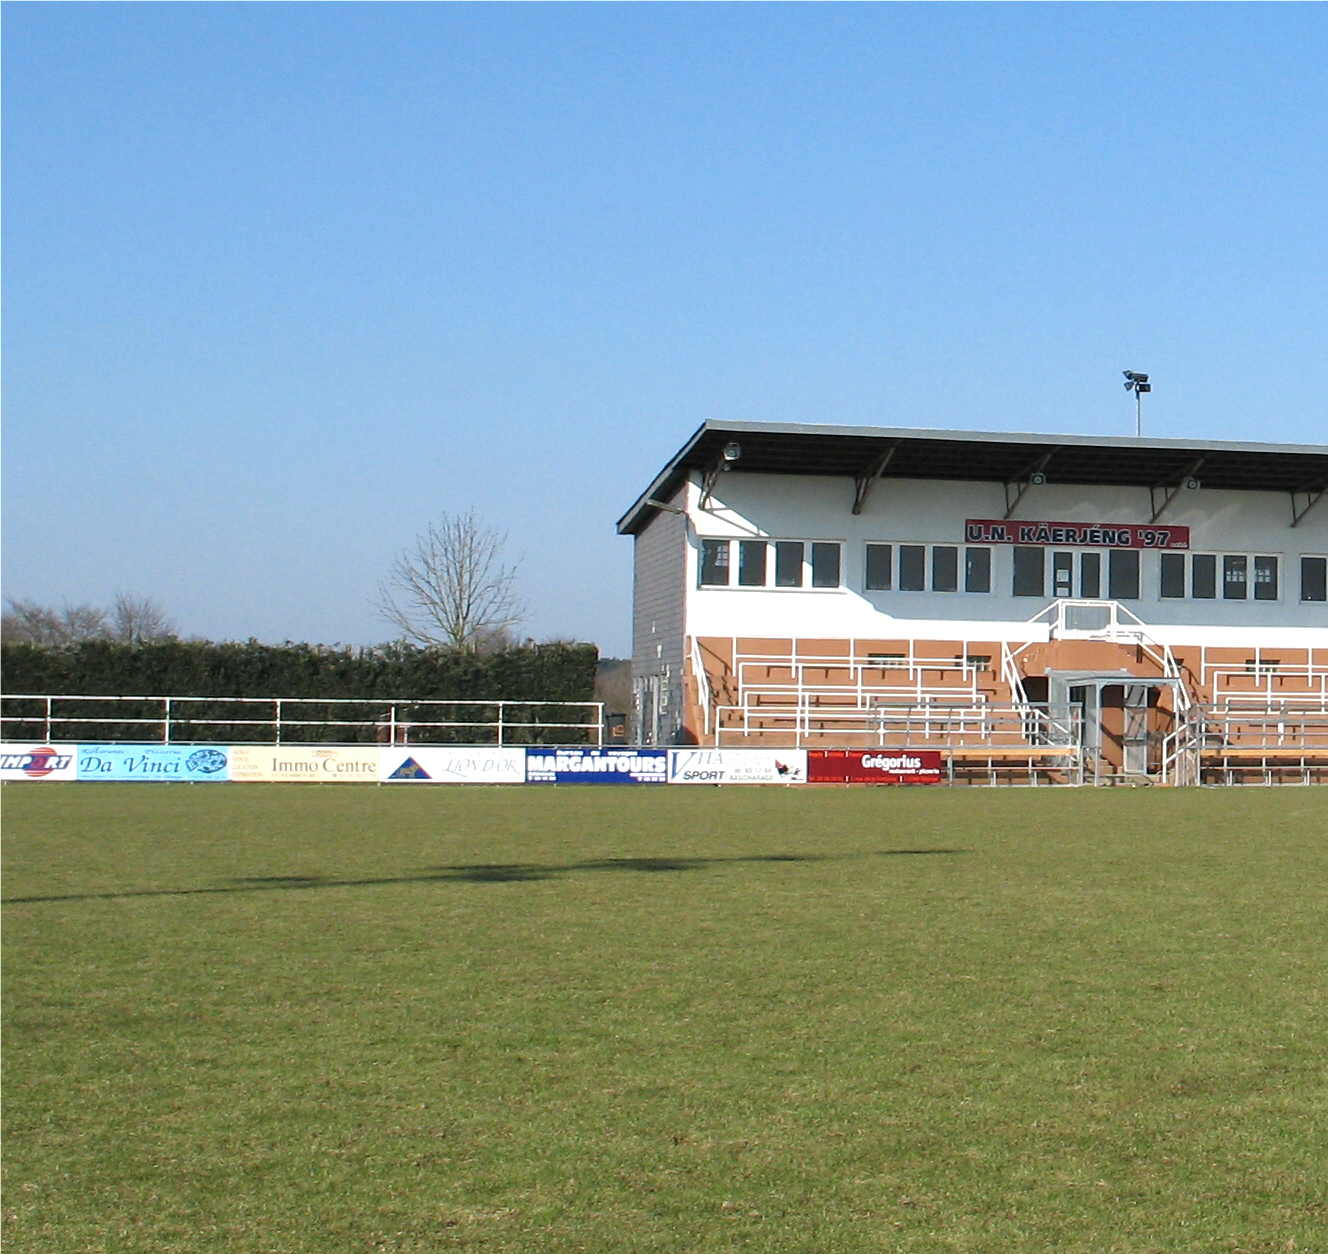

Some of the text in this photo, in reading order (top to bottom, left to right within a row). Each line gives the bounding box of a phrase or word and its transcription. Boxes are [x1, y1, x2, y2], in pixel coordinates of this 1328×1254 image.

[968, 524, 1171, 547] U.N. KÄERJÉNG '97
[80, 754, 181, 773] Da Vinci
[272, 758, 376, 772] Immo Centre
[527, 755, 666, 772] MARGANTOURS
[861, 754, 921, 770] Grégorius
[683, 771, 726, 780] SPORT
